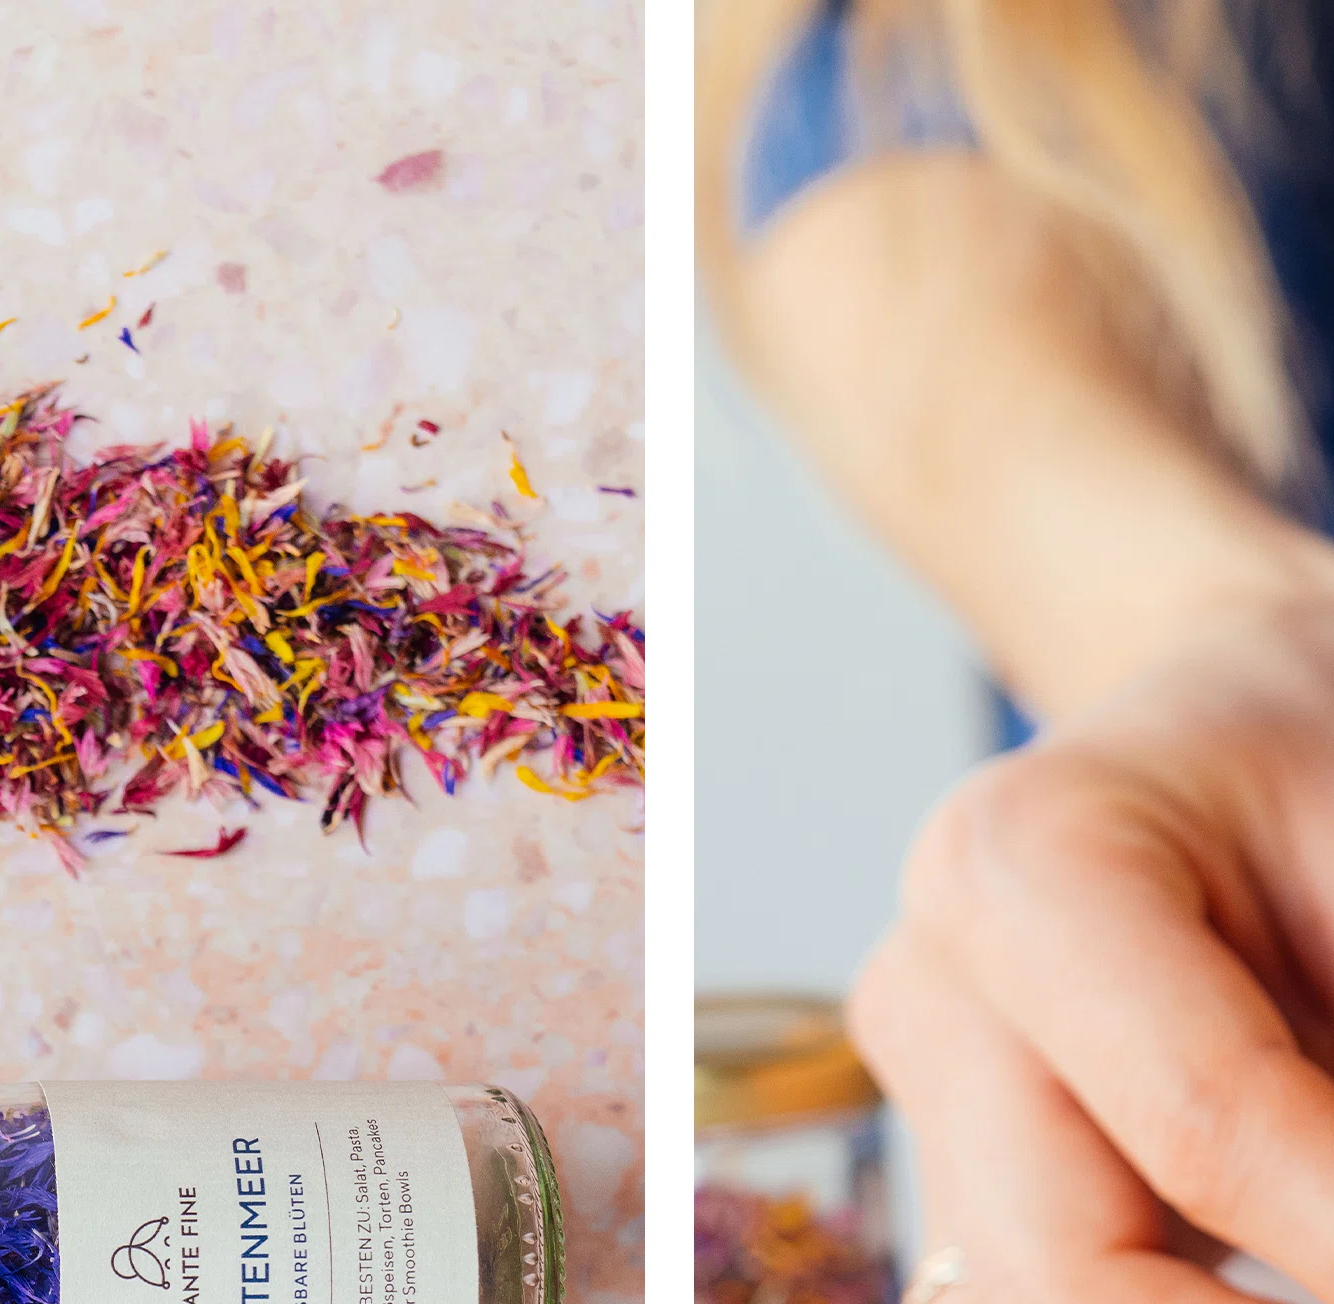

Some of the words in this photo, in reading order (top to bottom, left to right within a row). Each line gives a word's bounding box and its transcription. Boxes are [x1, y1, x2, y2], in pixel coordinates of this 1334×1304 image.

[348, 1126, 363, 1161] Pasta,
[367, 1119, 387, 1174] Pancakes
[354, 1165, 369, 1203] Salat,
[379, 1179, 392, 1232] Torten,
[396, 1171, 412, 1213] Bowls
[179, 1187, 198, 1236] FINE
[288, 1175, 307, 1243] BLÜTEN
[357, 1207, 371, 1233] ZU:
[401, 1218, 416, 1295] Smoothie
